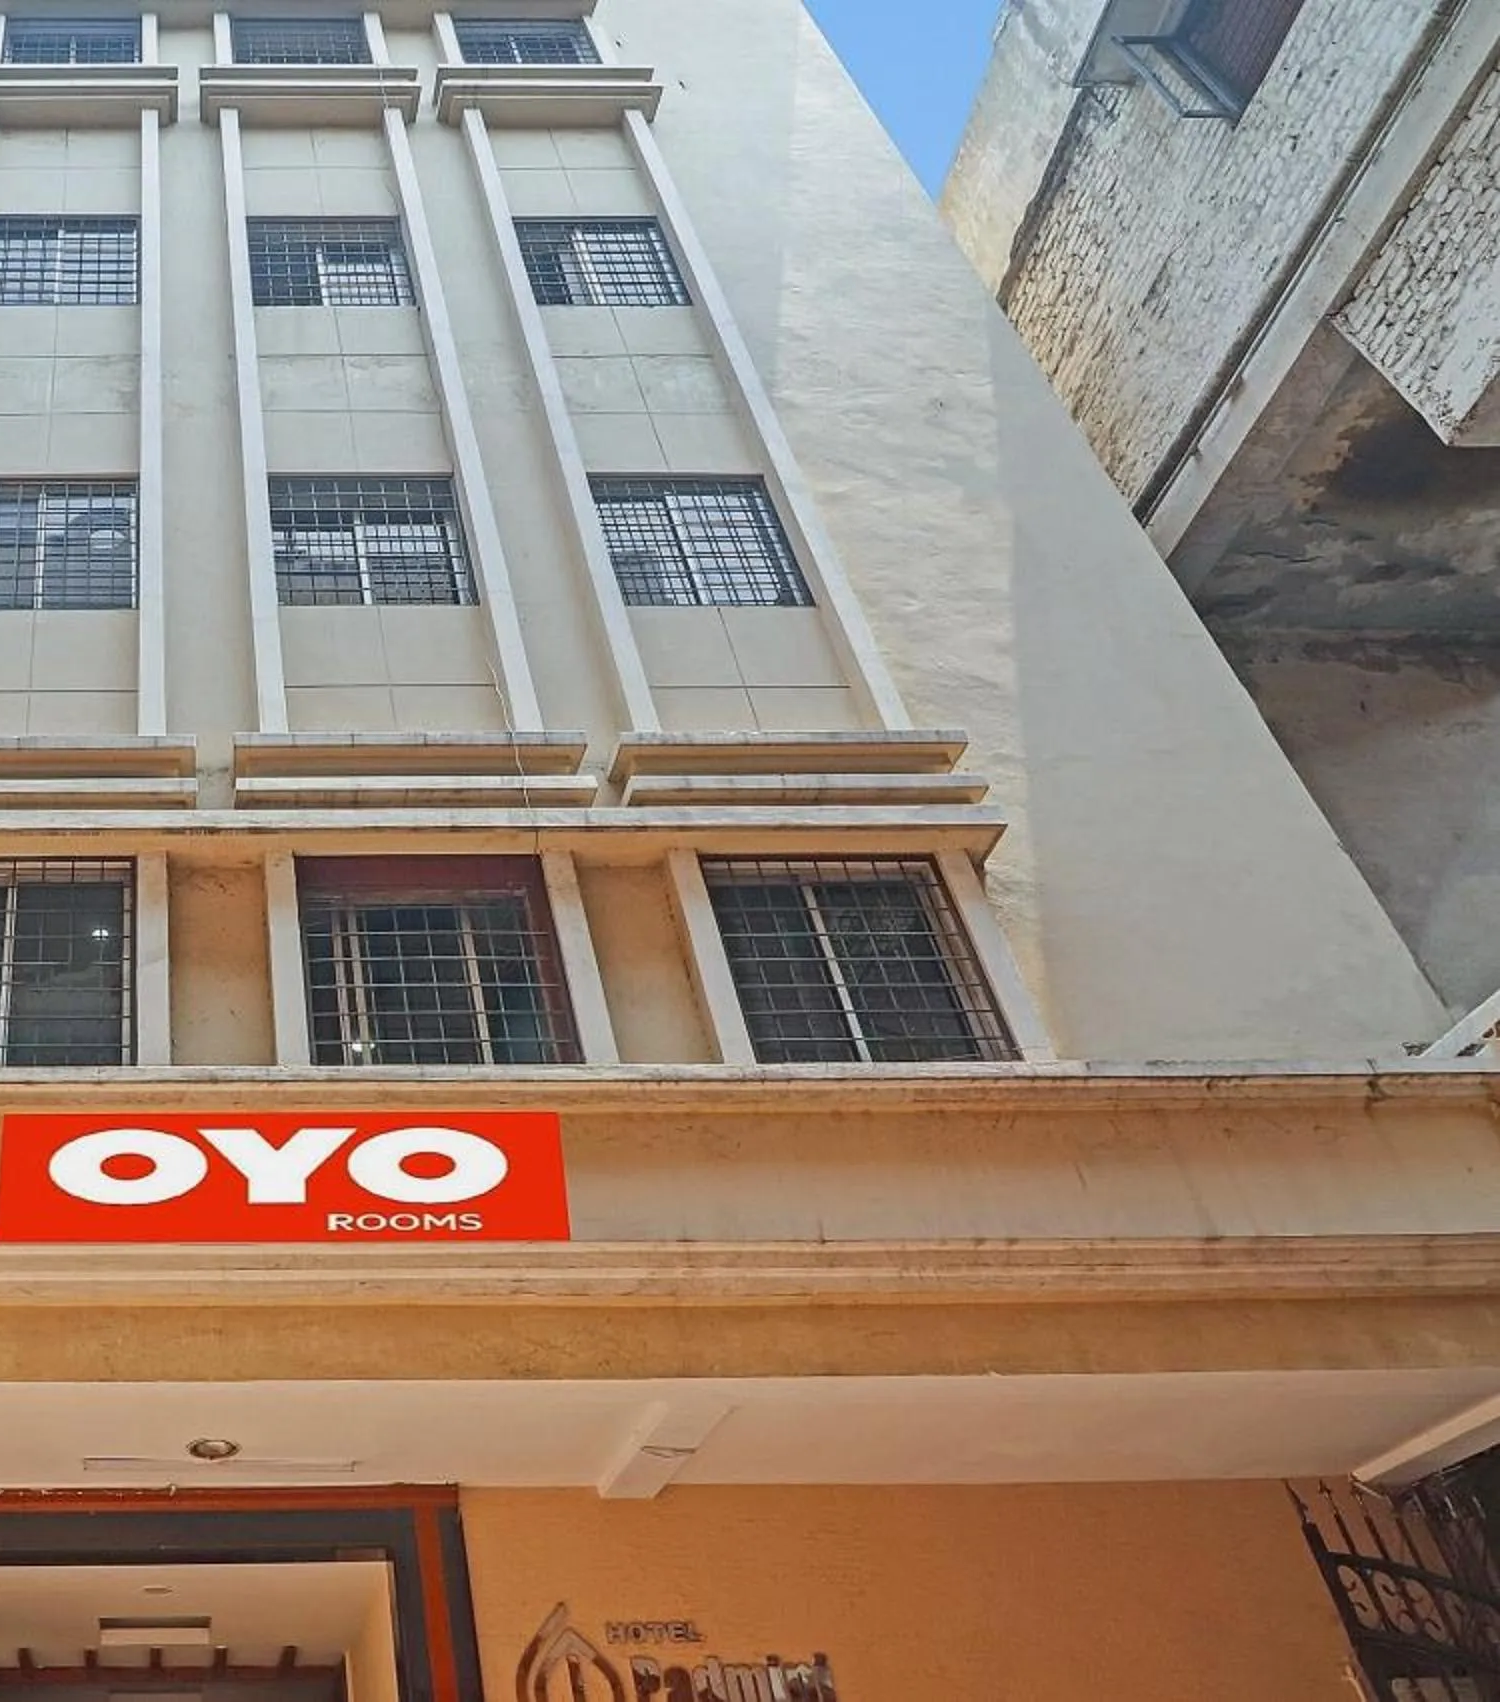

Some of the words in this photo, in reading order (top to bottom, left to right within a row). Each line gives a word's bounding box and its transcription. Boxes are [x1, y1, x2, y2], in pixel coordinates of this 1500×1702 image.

[48, 1127, 508, 1205] OYO
[327, 1212, 483, 1232] ROOMS
[605, 1620, 705, 1645] HOTEL
